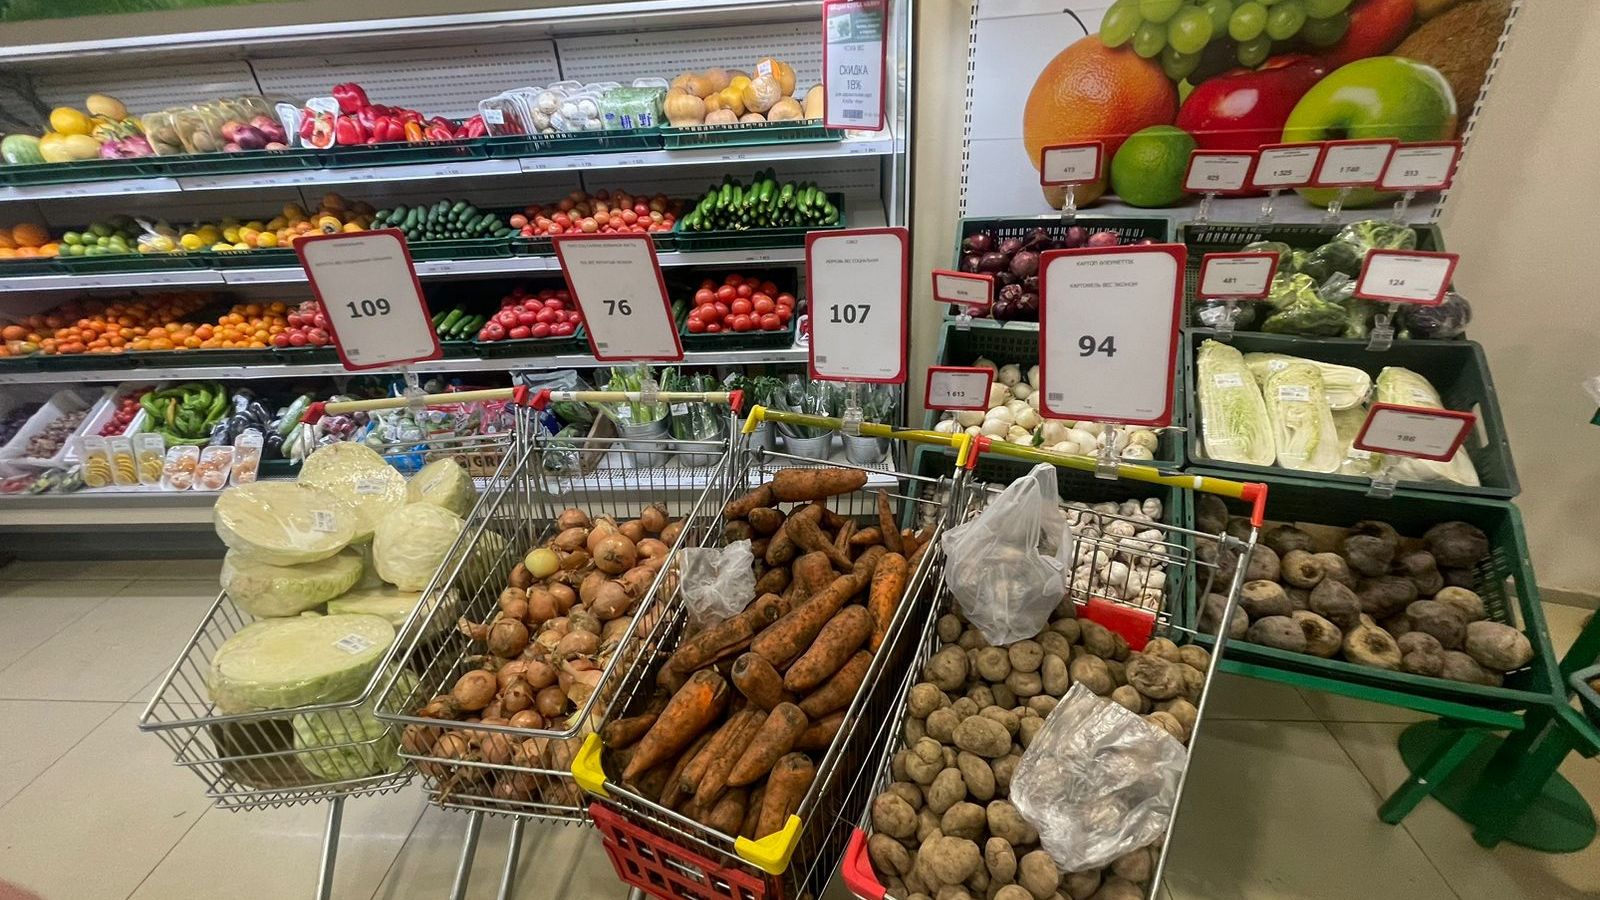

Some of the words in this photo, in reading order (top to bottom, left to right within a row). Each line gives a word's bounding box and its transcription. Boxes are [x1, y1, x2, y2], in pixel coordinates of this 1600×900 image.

[839, 64, 869, 76] СКИДКА
[847, 79, 862, 90] 18%
[346, 298, 391, 318] 109
[602, 299, 632, 316] 76
[830, 304, 871, 324] 107
[1078, 335, 1117, 357] 94
